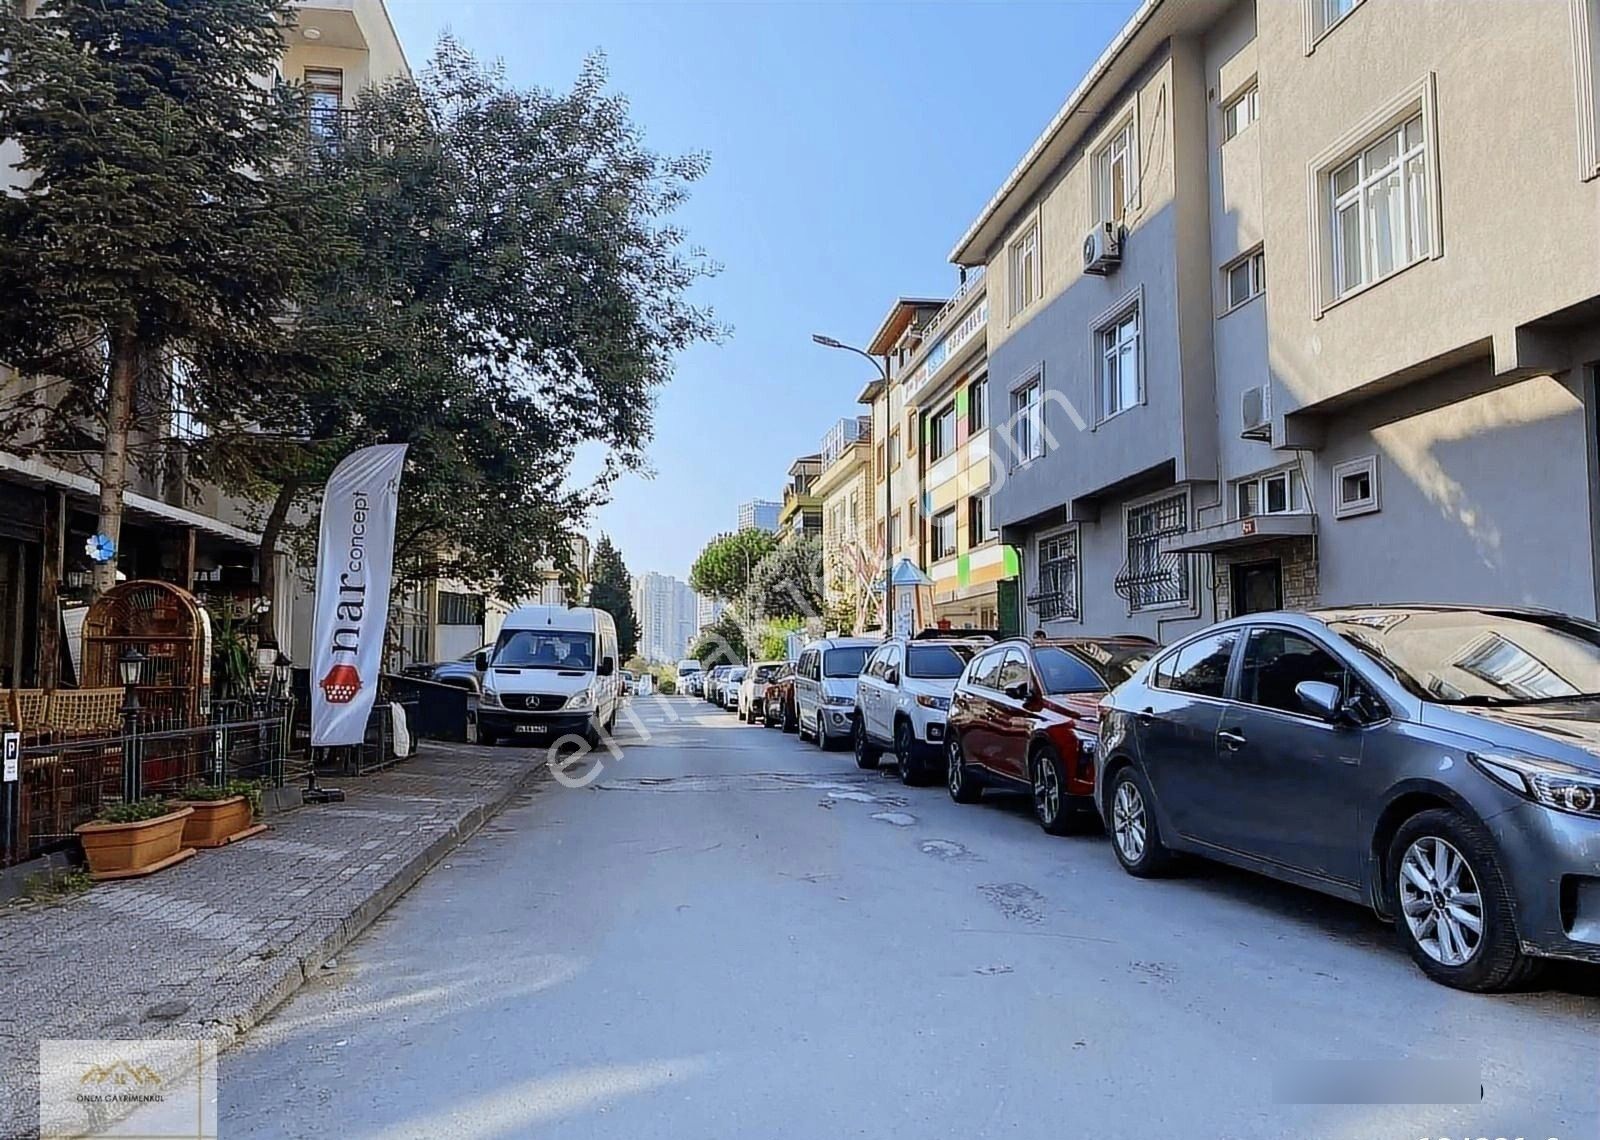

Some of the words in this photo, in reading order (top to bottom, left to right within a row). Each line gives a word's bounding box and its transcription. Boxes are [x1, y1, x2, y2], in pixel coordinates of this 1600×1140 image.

[348, 490, 370, 572] concept
[332, 574, 366, 655] nar
[8, 741, 15, 758] P
